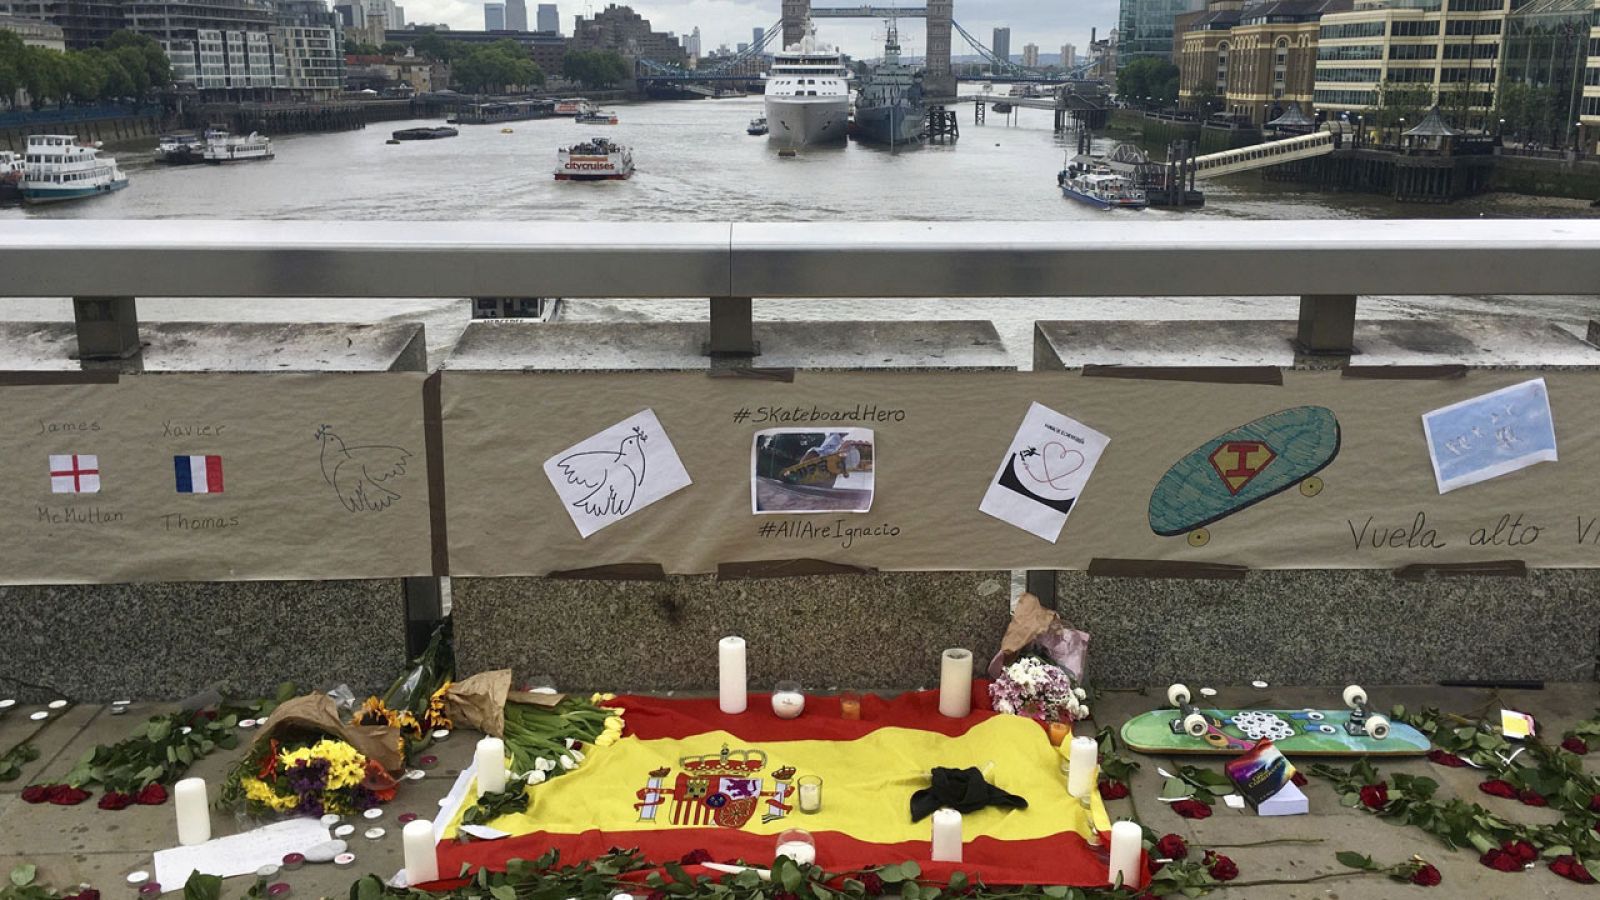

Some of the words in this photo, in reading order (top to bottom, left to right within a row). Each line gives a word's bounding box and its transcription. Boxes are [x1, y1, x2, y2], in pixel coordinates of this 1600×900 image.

[564, 161, 616, 171] citycruises
[37, 419, 101, 435] James
[161, 419, 226, 438] Xavier
[160, 512, 241, 531] Thomas
[1348, 511, 1447, 550] Vuela
[1469, 513, 1546, 546] alto
[758, 519, 901, 549] #AllAreIgnacio
